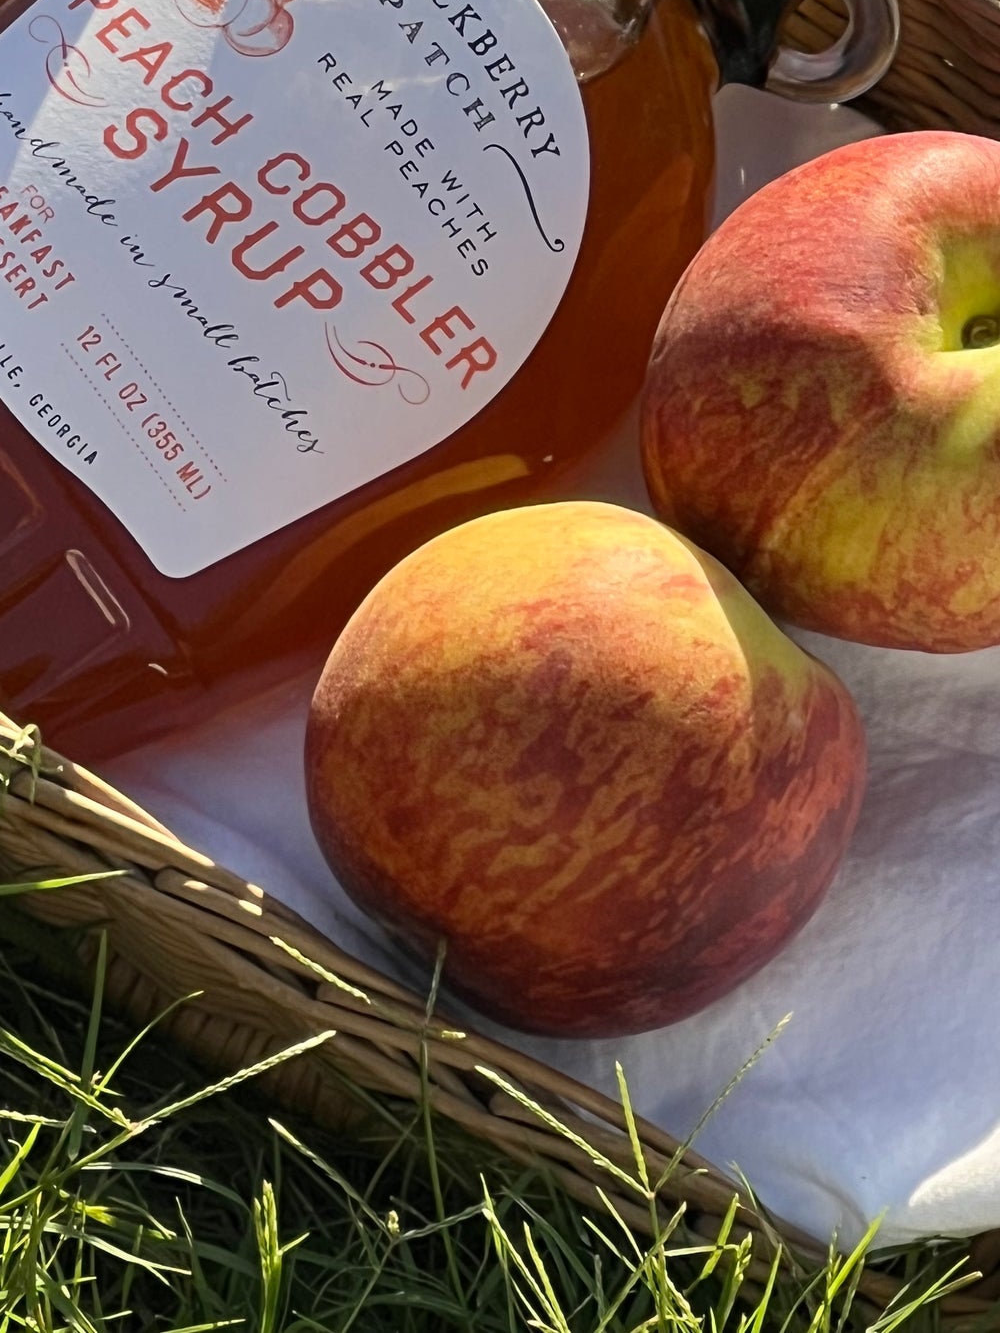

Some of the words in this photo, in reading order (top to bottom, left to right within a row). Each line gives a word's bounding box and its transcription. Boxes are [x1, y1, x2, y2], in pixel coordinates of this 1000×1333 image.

[21, 184, 55, 223] FOR
[102, 107, 343, 310] SYRUP
[317, 52, 375, 128] REAL
[384, 140, 489, 277] PEACHES
[371, 79, 435, 158] MADE
[440, 169, 498, 243] WITH
[120, 234, 155, 267] in
[148, 273, 239, 349] small
[227, 355, 324, 455] batches
[257, 152, 498, 391] COBBLER
[29, 393, 98, 466] GEORGIA
[76, 325, 102, 353] 12
[95, 352, 122, 381] FL
[118, 382, 148, 412] OZ
[141, 412, 184, 461] (355
[176, 461, 212, 501] ML)
